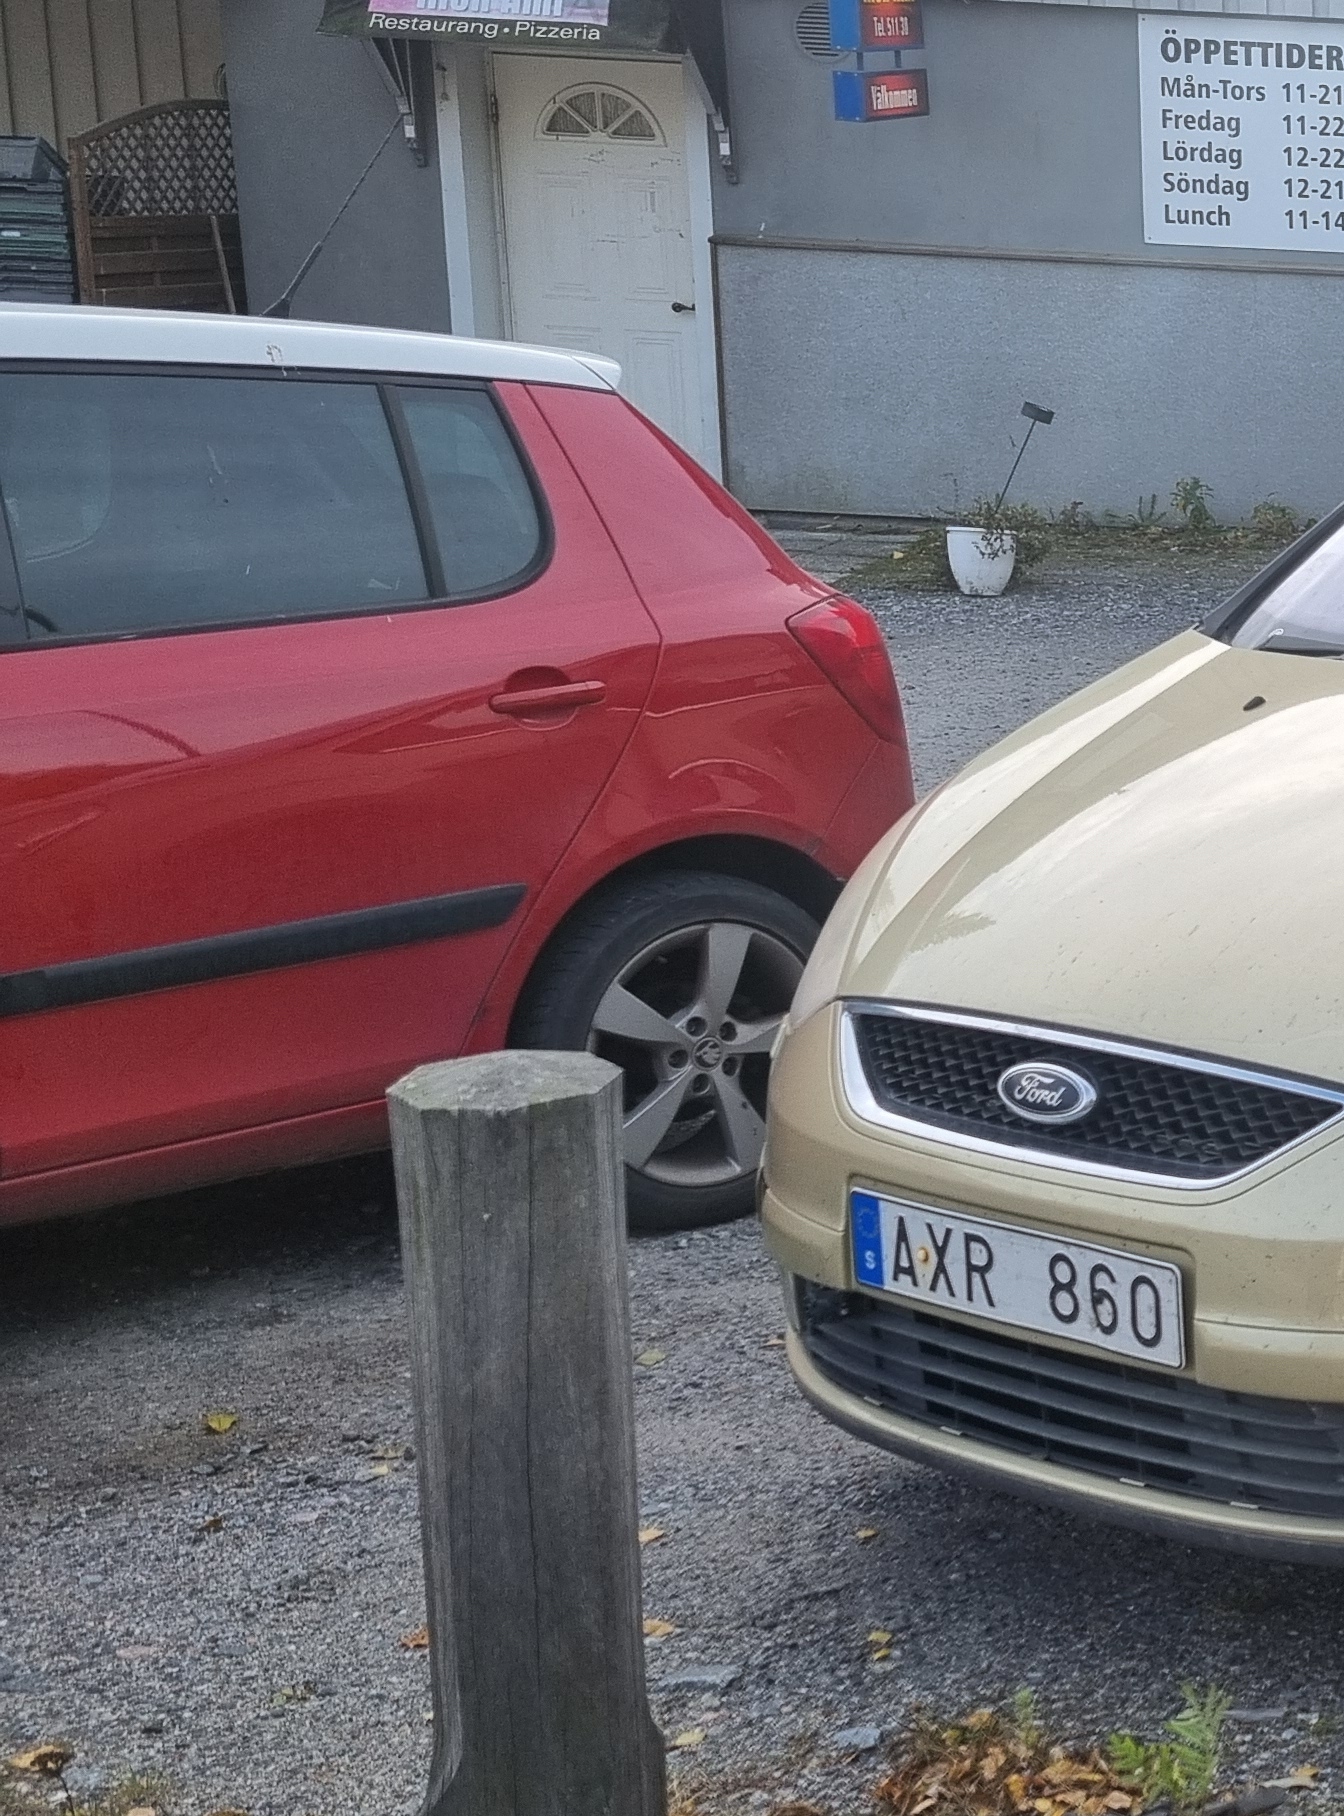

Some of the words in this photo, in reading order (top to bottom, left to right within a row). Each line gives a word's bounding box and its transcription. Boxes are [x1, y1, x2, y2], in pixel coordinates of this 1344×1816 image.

[369, 13, 499, 39] Restaurang
[514, 21, 601, 41] Pizzeria
[1160, 29, 1344, 71] ÖPPETTIDER
[871, 85, 917, 110] Välkommen
[1160, 74, 1267, 102] Mån-Tors
[1281, 82, 1343, 106] 11-21
[1161, 108, 1242, 138] Fredag
[1162, 140, 1243, 170] Lördag
[1163, 172, 1250, 202] Söndag
[1284, 178, 1344, 200] 12-21
[1164, 204, 1231, 227] Lunch
[1014, 1073, 1066, 1107] Ford
[865, 1251, 876, 1270] S
[892, 1215, 996, 1307] AXR
[1049, 1252, 1162, 1348] 860
